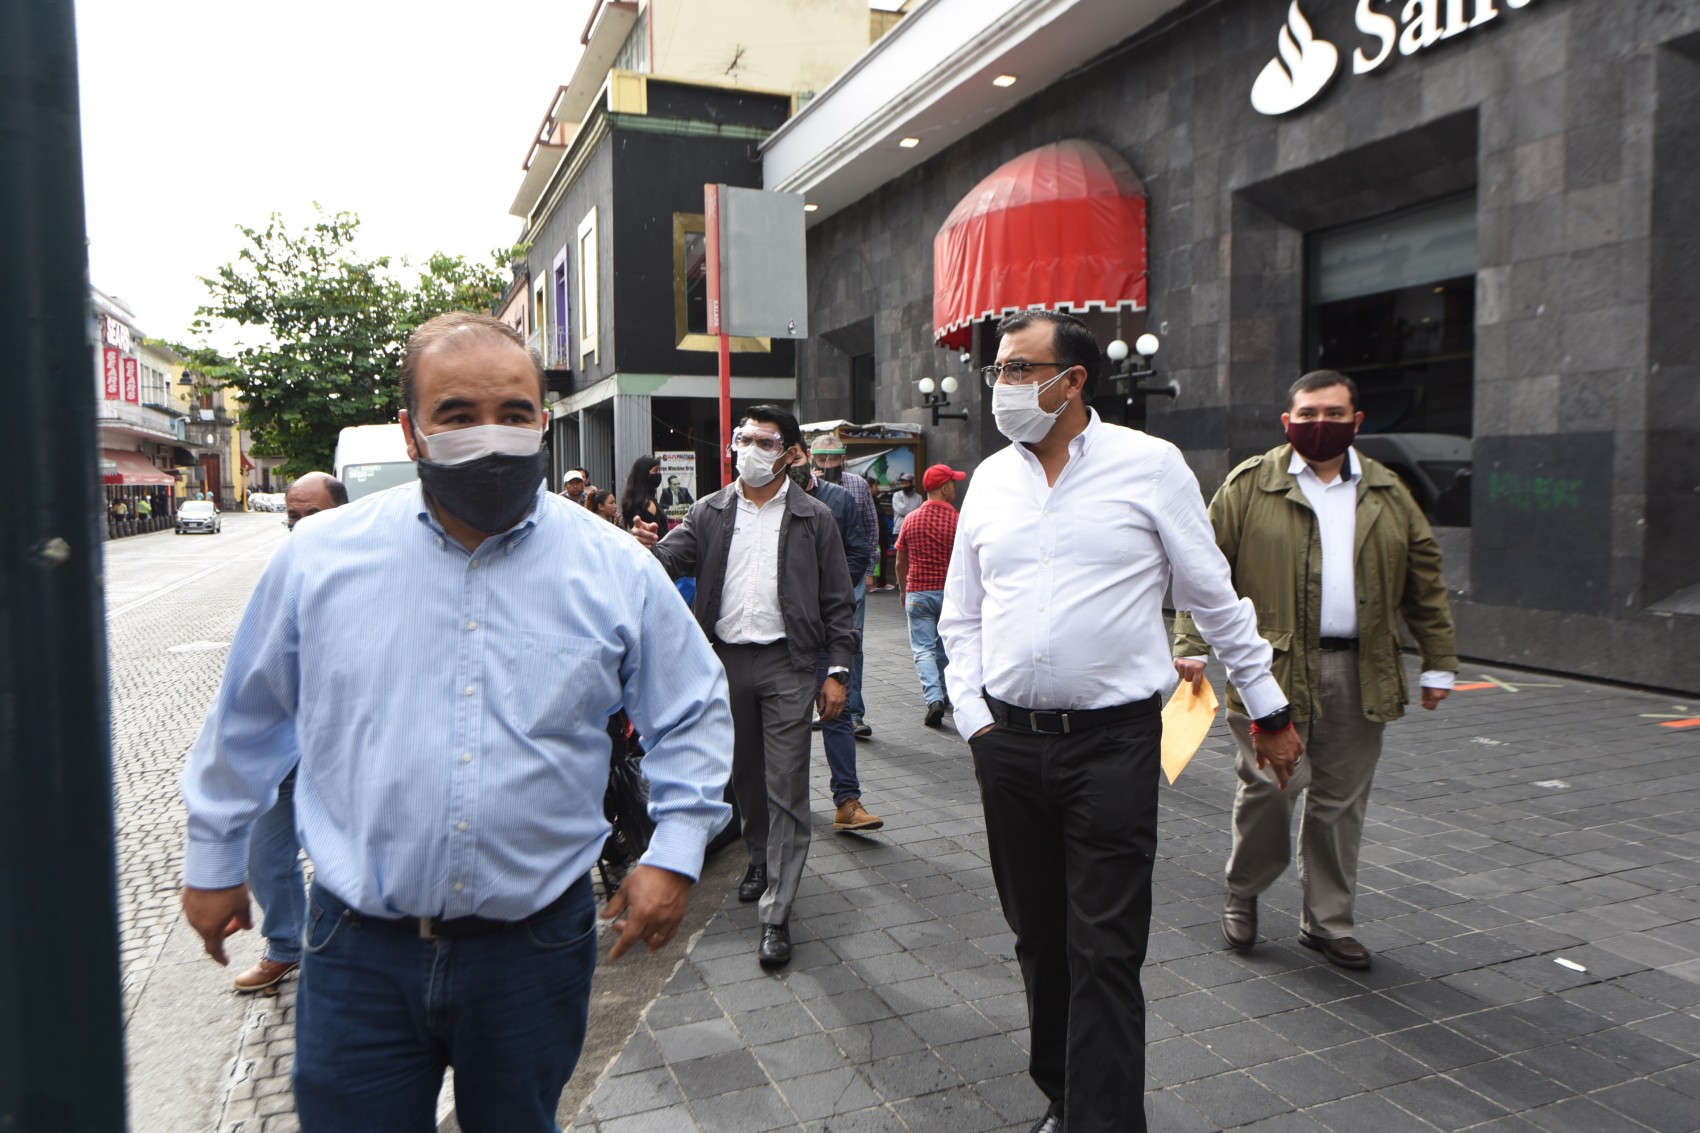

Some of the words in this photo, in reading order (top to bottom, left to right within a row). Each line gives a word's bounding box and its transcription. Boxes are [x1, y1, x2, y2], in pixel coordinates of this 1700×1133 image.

[1353, 0, 1531, 75] San
[106, 316, 130, 353] SEARS
[107, 352, 118, 392] SEARS
[126, 361, 136, 400] SEARS
